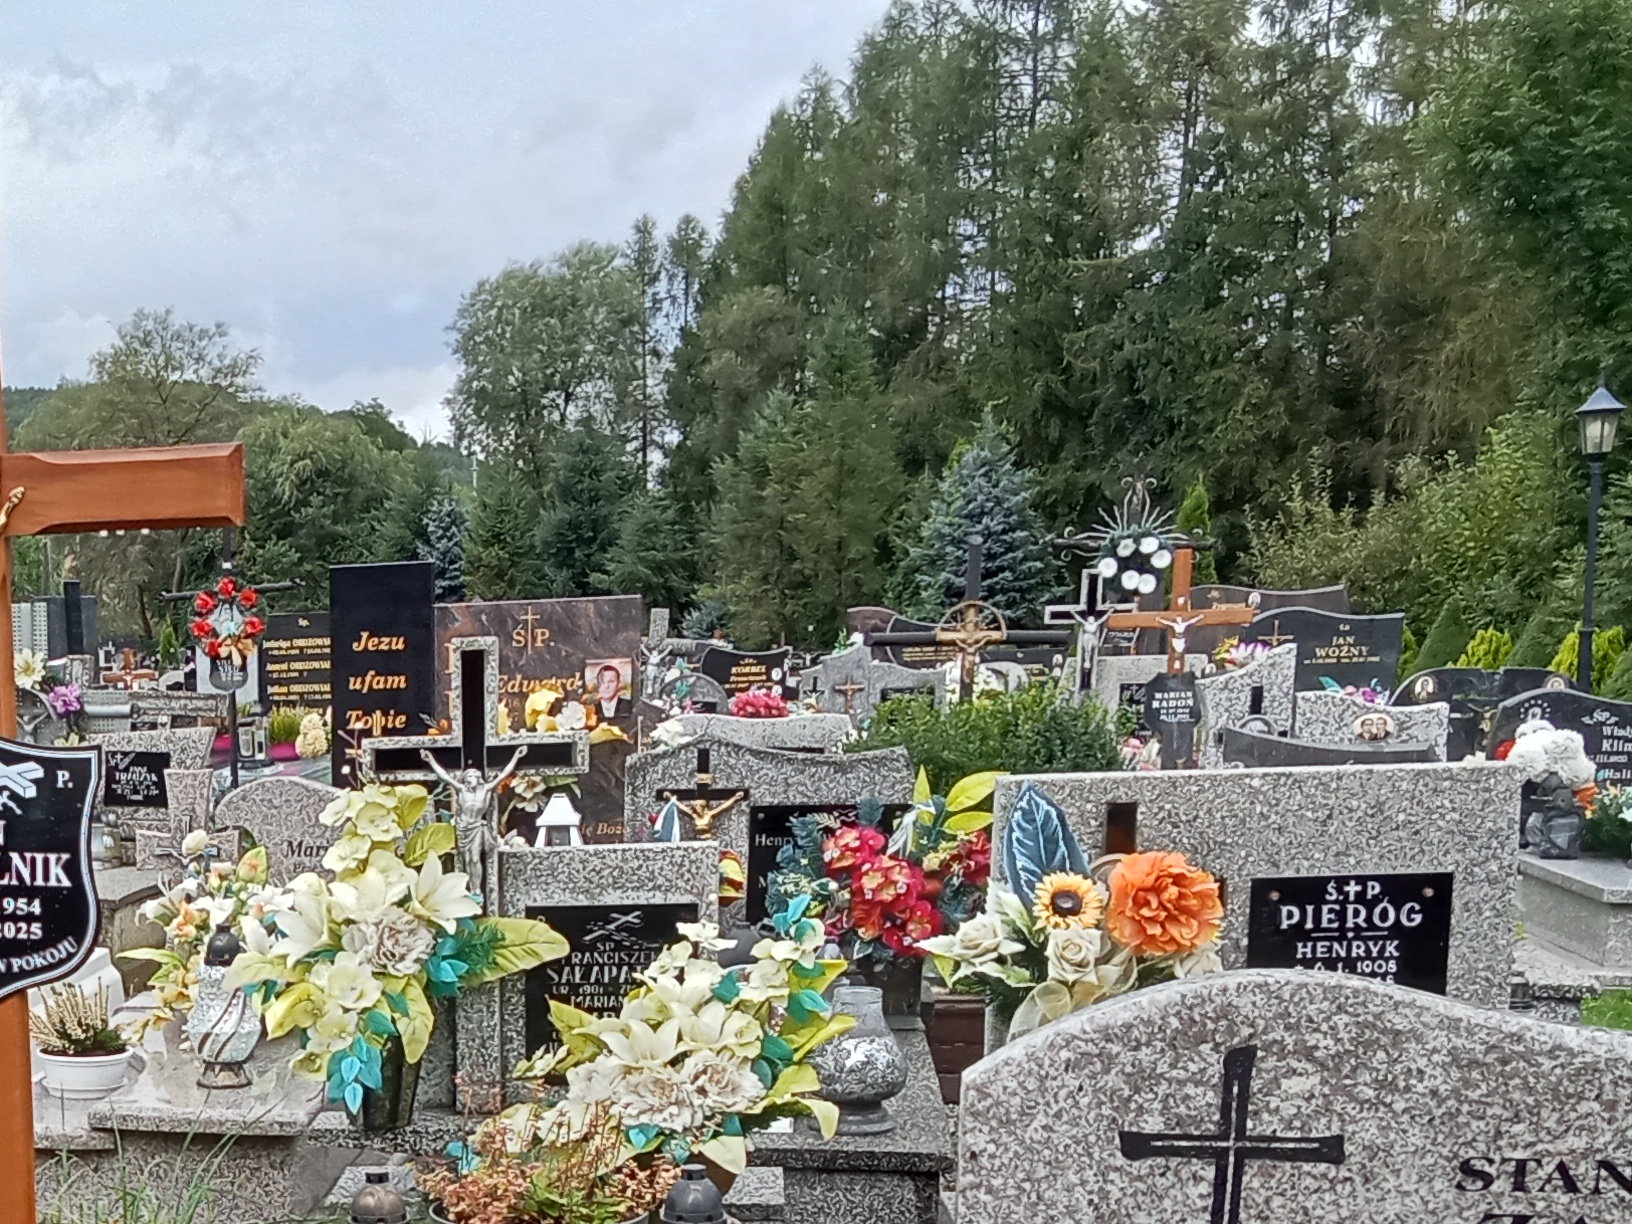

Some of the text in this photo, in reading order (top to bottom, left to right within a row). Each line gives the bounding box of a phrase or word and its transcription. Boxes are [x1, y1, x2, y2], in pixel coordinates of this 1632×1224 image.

[352, 631, 406, 651] Jezu
[1332, 636, 1356, 646] JAN
[349, 670, 407, 694] ufam
[56, 770, 74, 789] P.
[1279, 896, 1424, 930] PIERÓG
[12, 936, 78, 973] POKOJU
[1295, 940, 1400, 959] HENRYK
